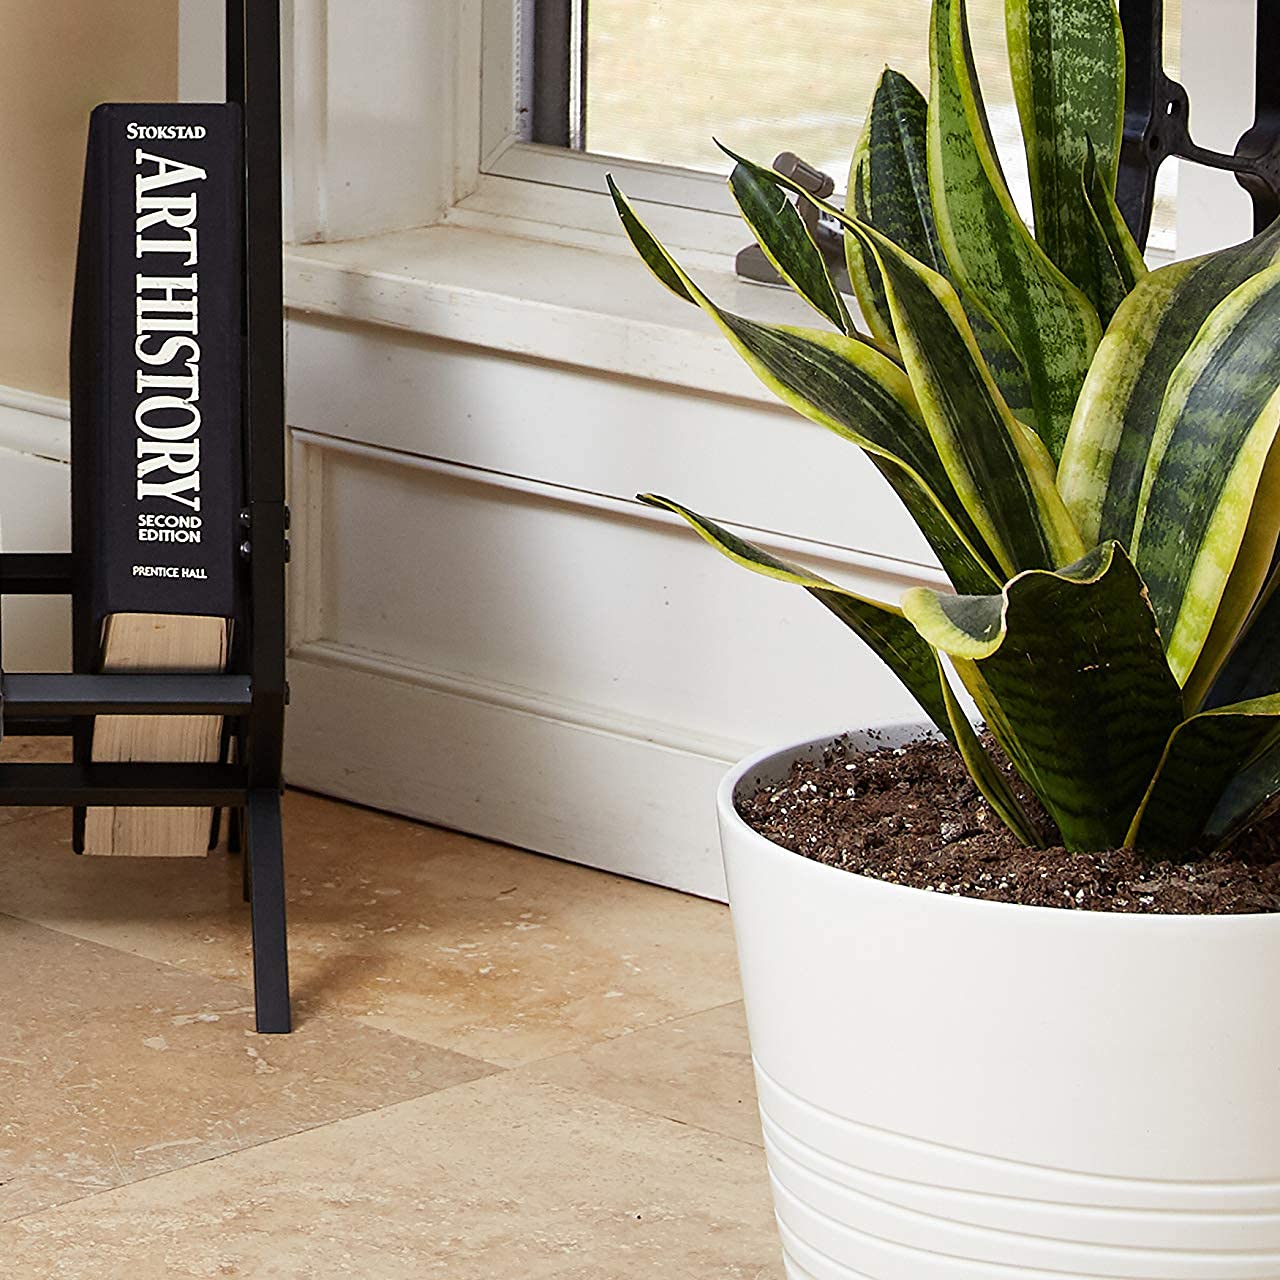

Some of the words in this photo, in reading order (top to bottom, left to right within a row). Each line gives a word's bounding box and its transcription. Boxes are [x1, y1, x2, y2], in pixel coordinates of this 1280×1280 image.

[126, 122, 206, 140] STOKSTAD
[134, 148, 207, 266] ART
[134, 272, 202, 512] HISTORY
[138, 514, 202, 528] SECOND
[138, 529, 201, 543] EDITION
[132, 565, 180, 578] PRENTICE
[181, 567, 208, 580] HALL
